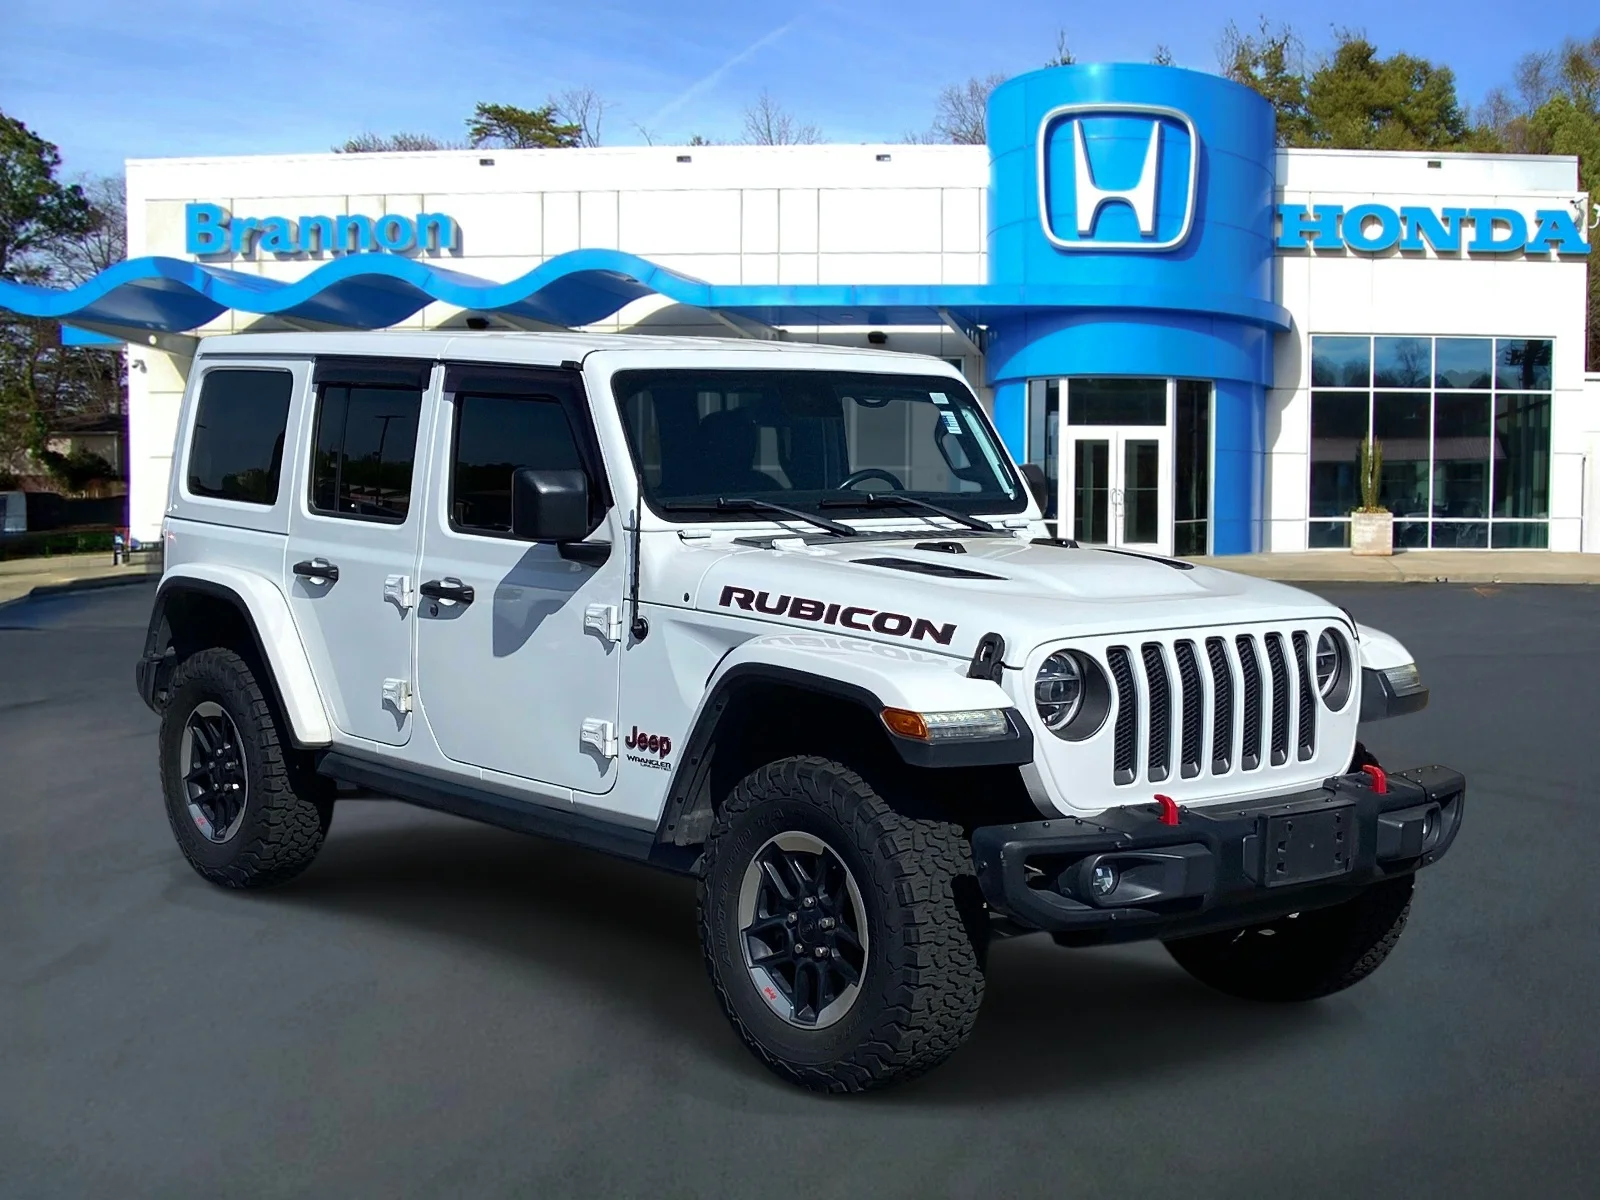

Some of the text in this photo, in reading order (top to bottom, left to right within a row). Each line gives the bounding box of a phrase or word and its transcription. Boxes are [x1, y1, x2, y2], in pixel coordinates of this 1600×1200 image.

[185, 202, 456, 256] Brannon
[1276, 203, 1592, 254] HONDA
[718, 585, 957, 646] RUBICON
[625, 725, 672, 760] Jeep
[626, 754, 672, 769] WRANGLER
